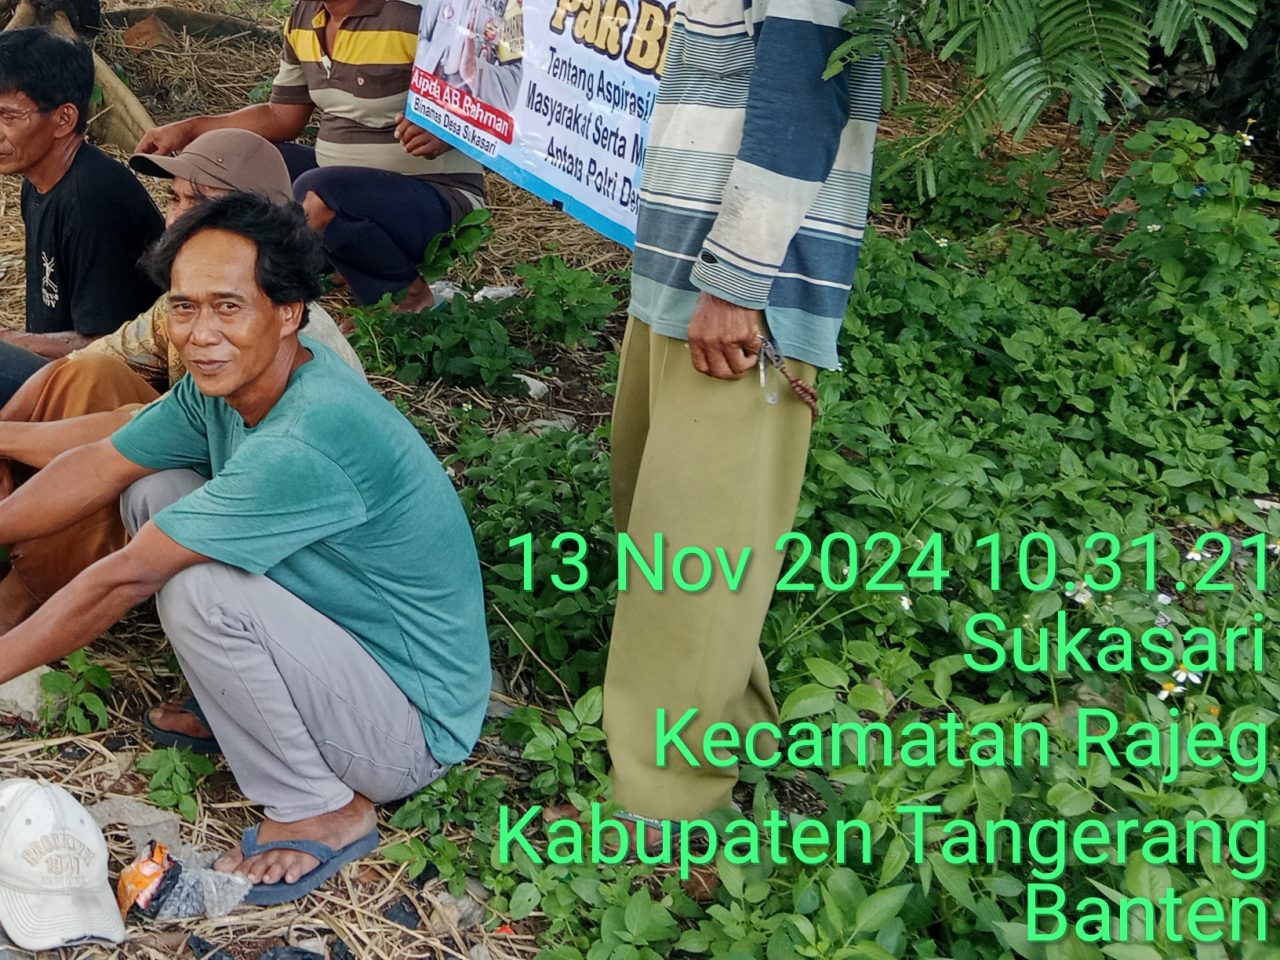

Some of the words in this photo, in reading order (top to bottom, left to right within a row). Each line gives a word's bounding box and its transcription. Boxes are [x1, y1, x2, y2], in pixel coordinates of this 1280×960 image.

[411, 70, 441, 102] Aipda
[442, 86, 461, 108] AB
[462, 95, 509, 138] Rahman
[547, 45, 594, 101] Tentang
[443, 114, 462, 136] Desa
[526, 80, 593, 140] Masyarakat
[592, 113, 627, 160] Serta
[631, 133, 647, 169] M
[544, 136, 584, 183] Antara
[586, 157, 619, 202] Polri
